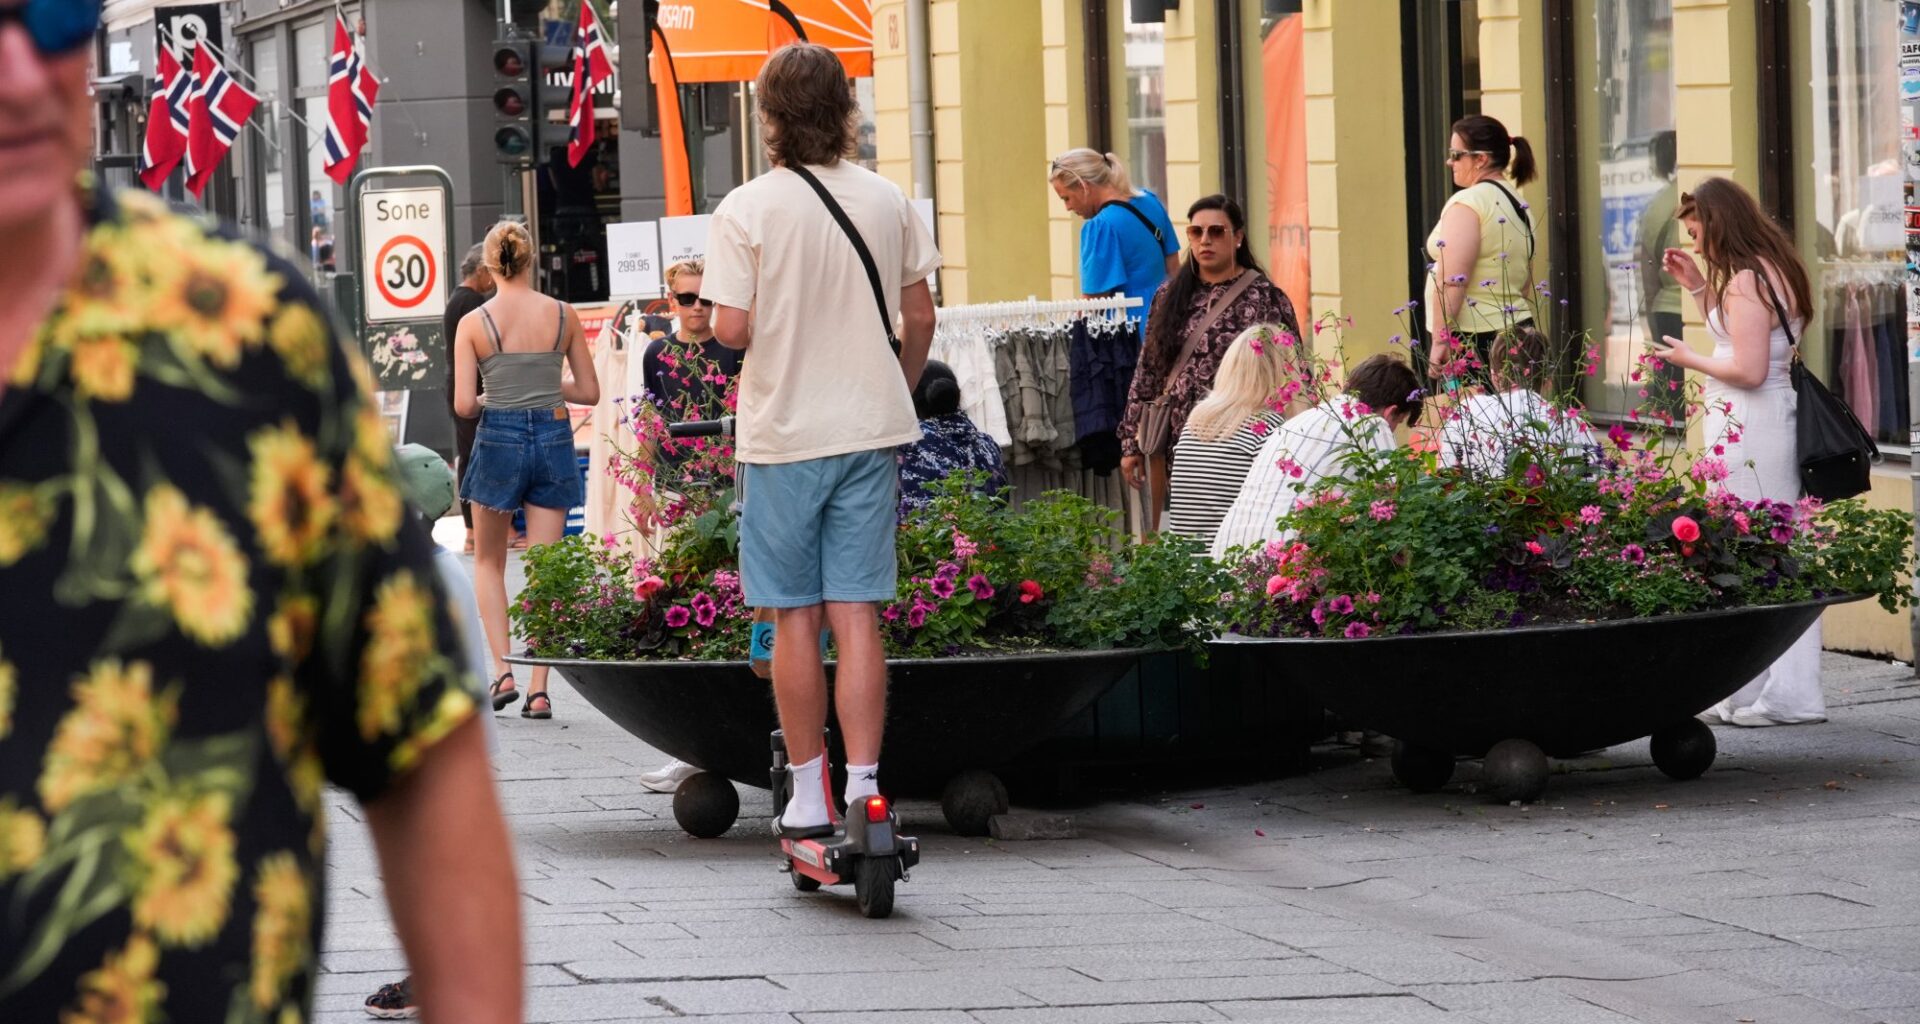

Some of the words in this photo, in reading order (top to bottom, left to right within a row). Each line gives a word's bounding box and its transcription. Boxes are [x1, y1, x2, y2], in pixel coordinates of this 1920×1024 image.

[376, 199, 430, 221] Sone
[386, 254, 425, 289] 30
[617, 259, 650, 273] 299.95
